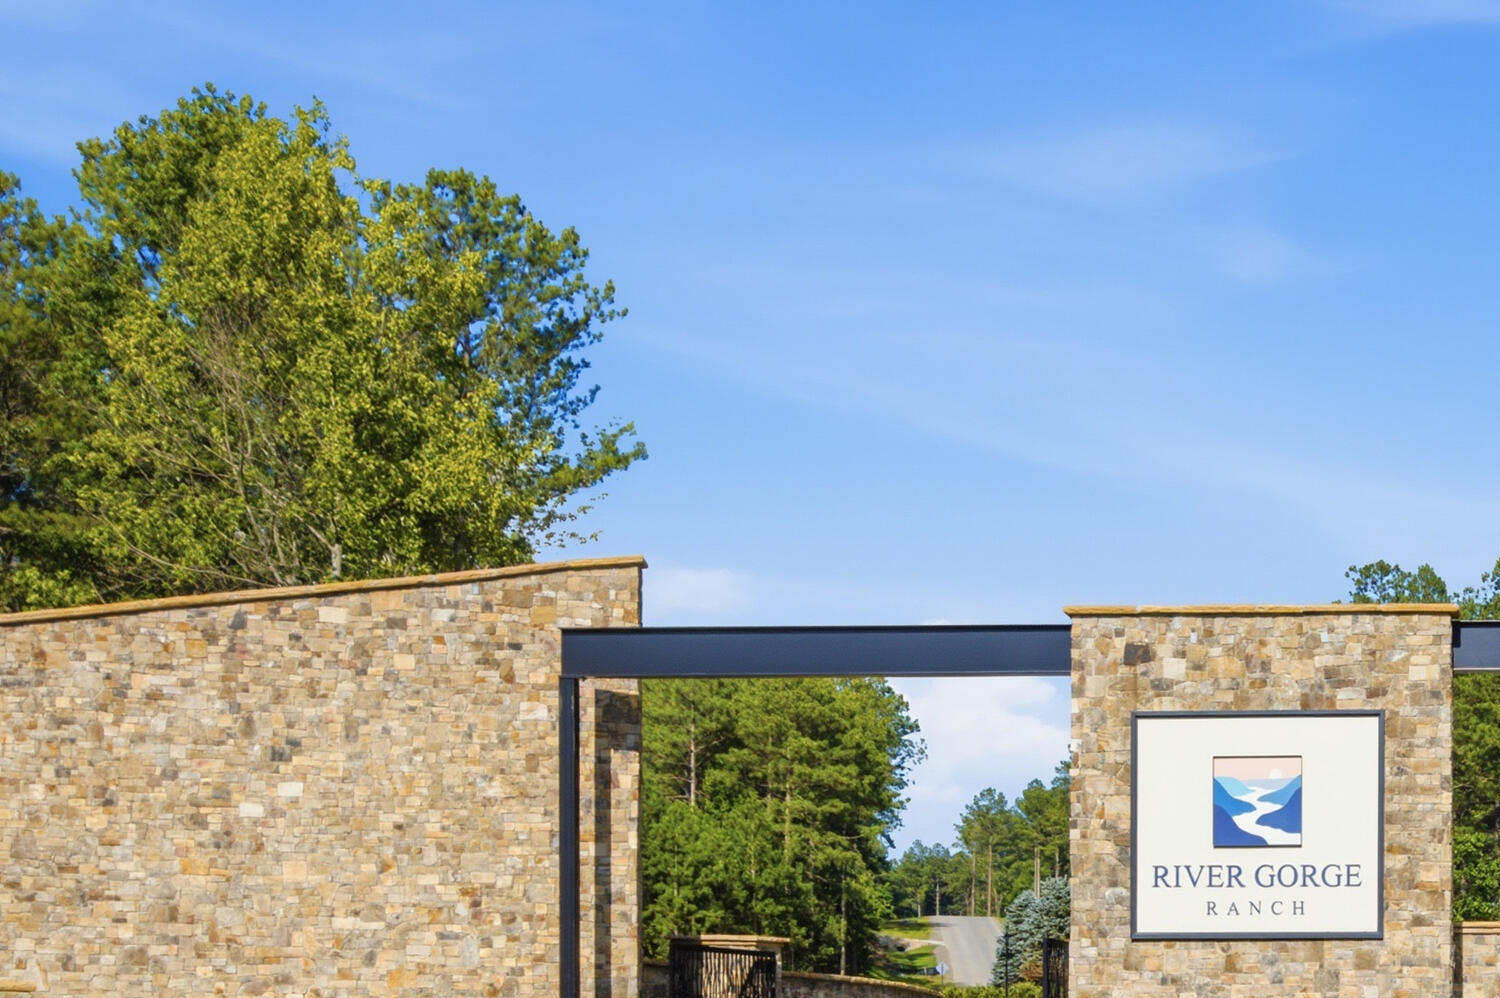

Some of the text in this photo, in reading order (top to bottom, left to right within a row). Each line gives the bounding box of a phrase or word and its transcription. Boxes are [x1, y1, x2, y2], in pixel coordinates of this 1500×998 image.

[1152, 864, 1362, 888] RIVER GORGE
[1206, 900, 1305, 916] RANCH
